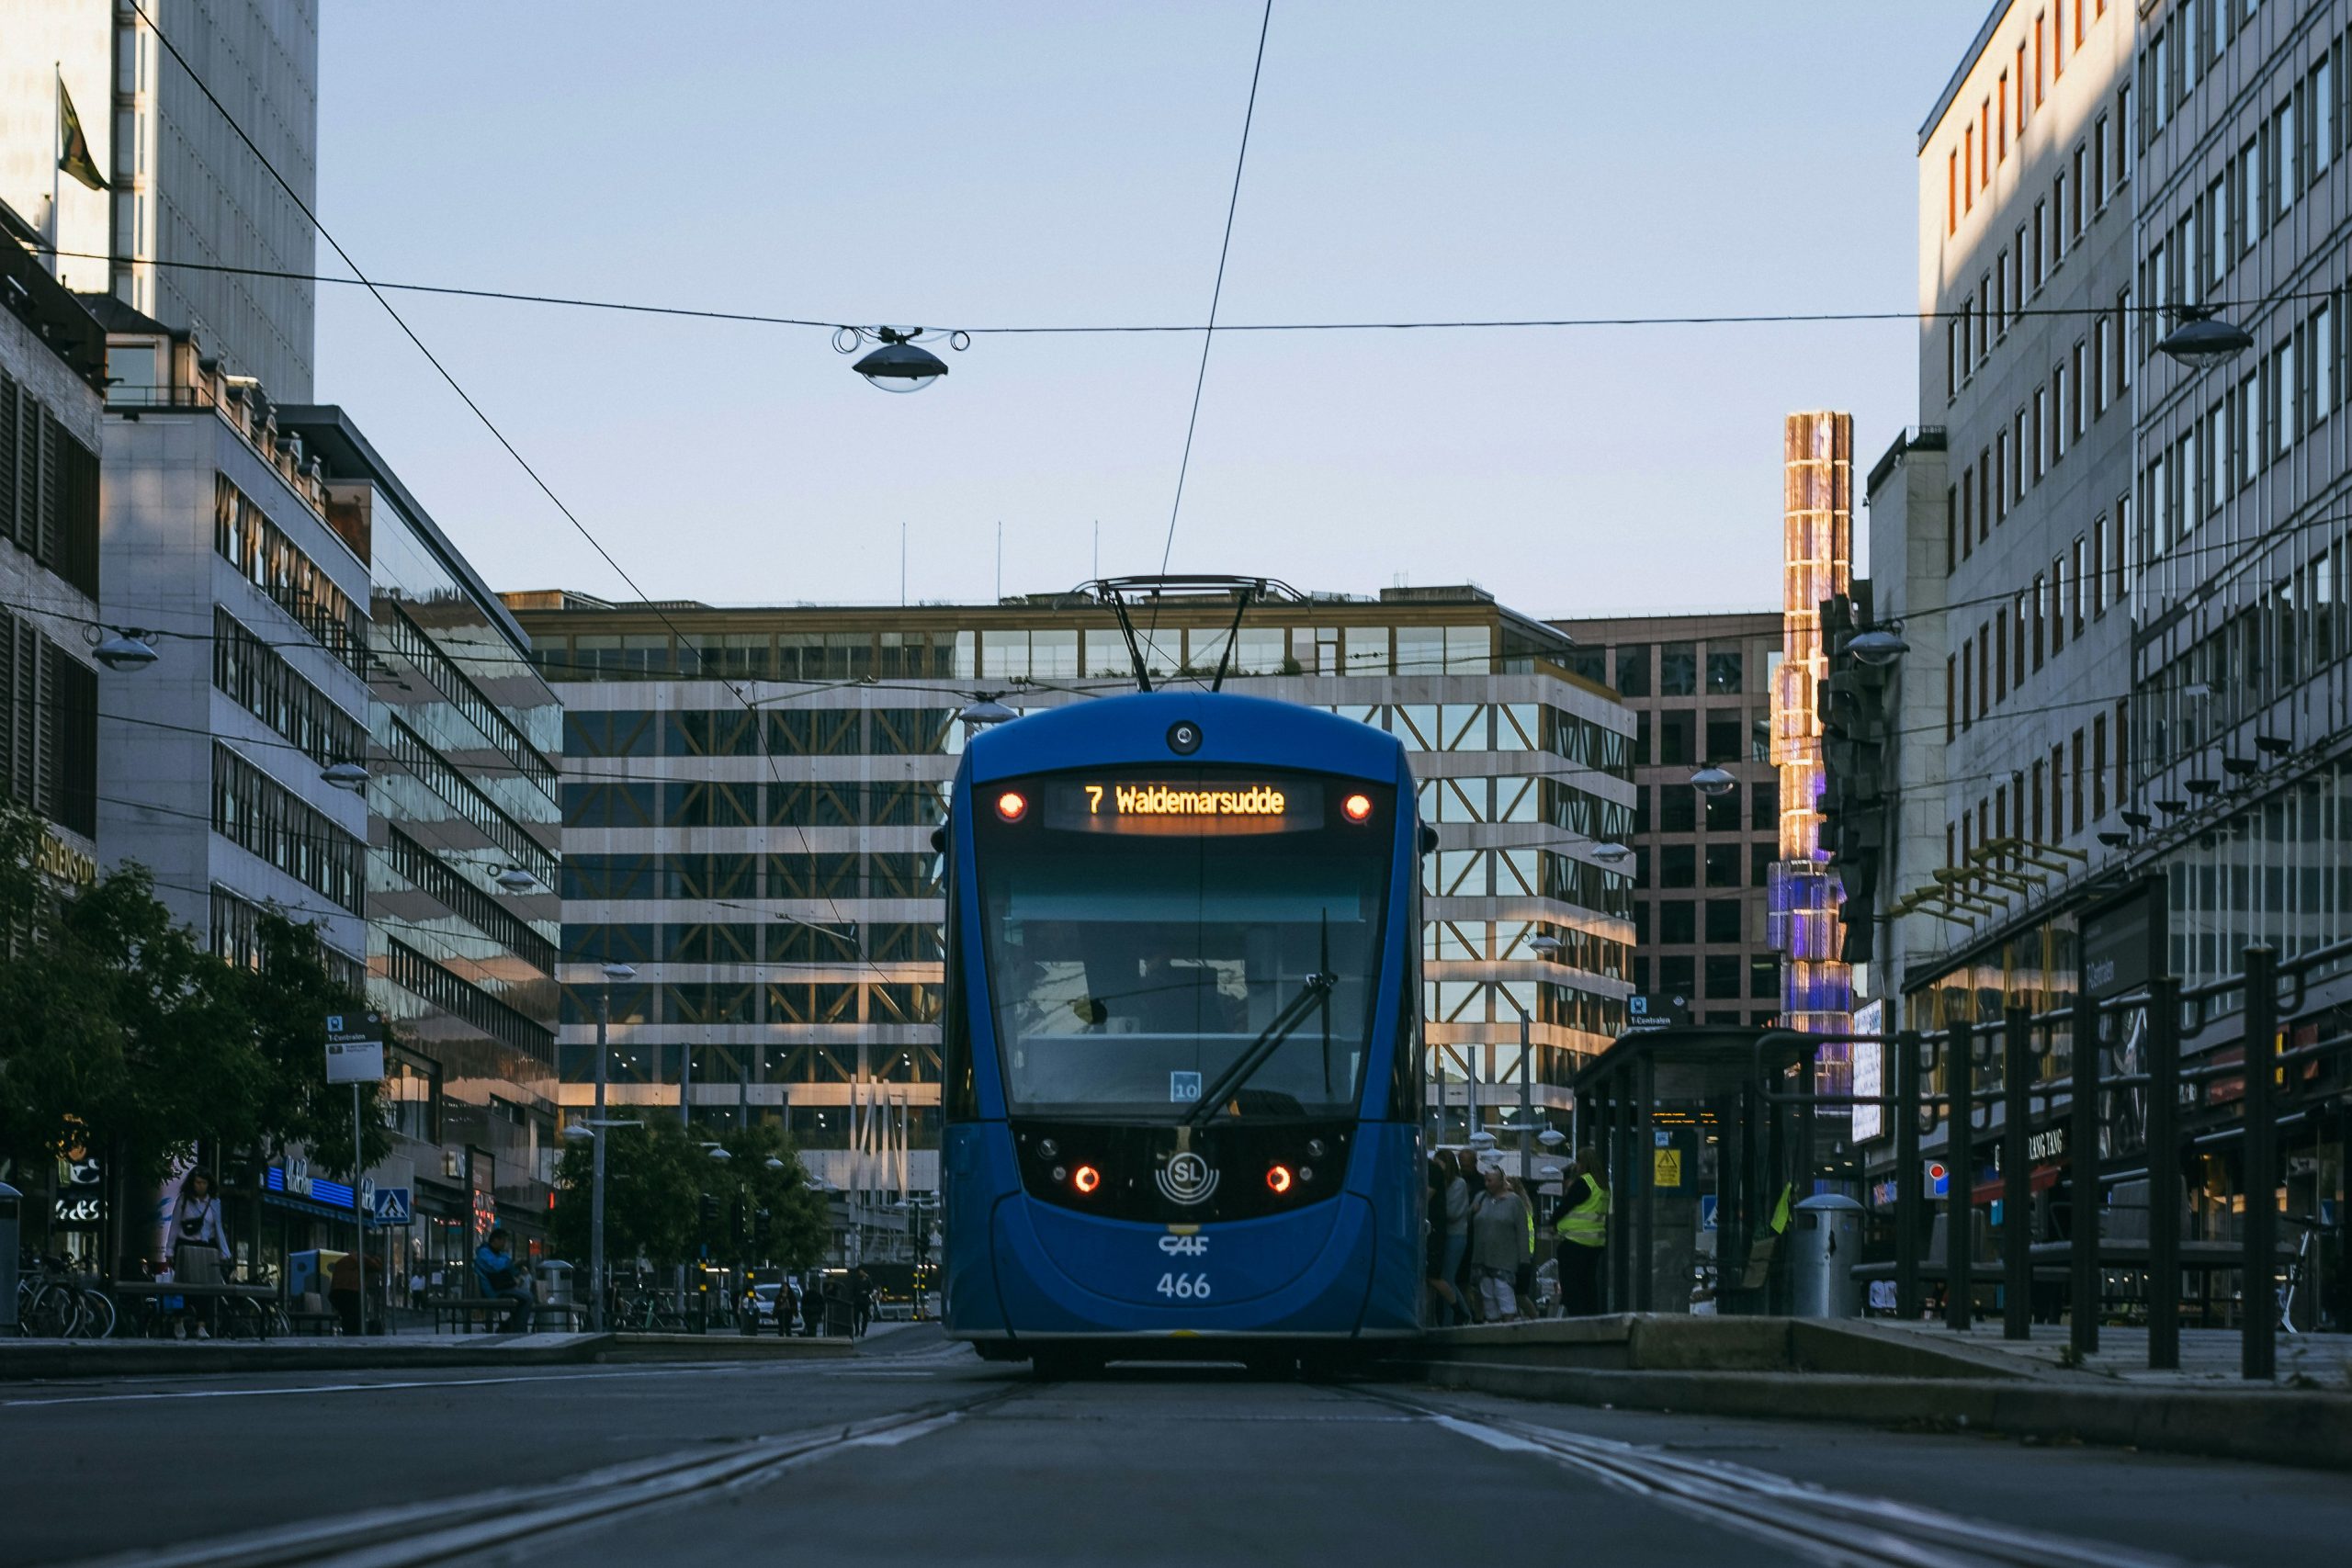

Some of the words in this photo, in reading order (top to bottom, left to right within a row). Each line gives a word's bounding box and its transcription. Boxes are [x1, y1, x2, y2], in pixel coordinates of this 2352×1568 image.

[1085, 785, 1103, 814] 7
[1115, 785, 1284, 815] Waldemarsudde
[328, 1033, 367, 1043] T-Centralen
[1175, 1084, 1197, 1099] 10
[1174, 1162, 1201, 1182] SL
[1159, 1235, 1209, 1257] CAF
[1157, 1272, 1211, 1299] 466
